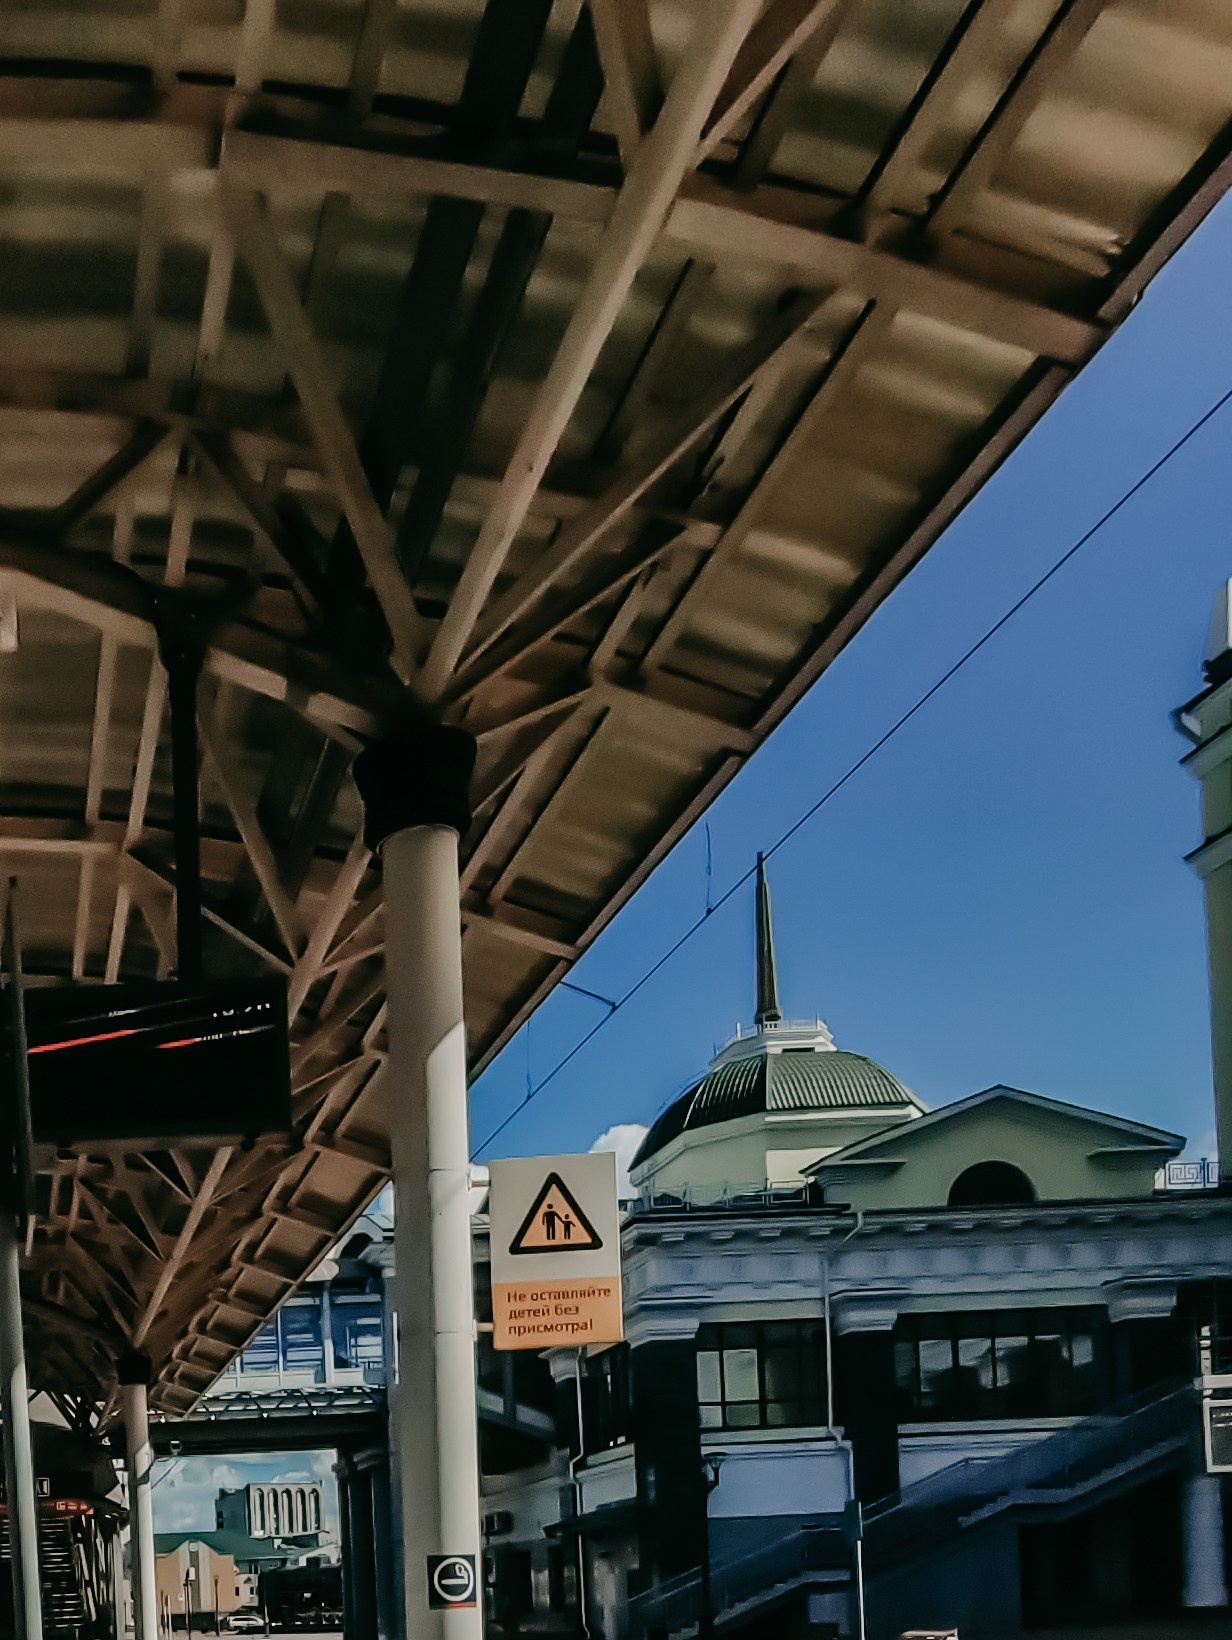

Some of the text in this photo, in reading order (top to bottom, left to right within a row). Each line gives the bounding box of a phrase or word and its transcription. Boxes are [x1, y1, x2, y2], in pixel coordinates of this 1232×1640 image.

[507, 1286, 611, 1303] Не оставляйте
[508, 1304, 580, 1320] детей без
[508, 1318, 593, 1337] присмотра!
